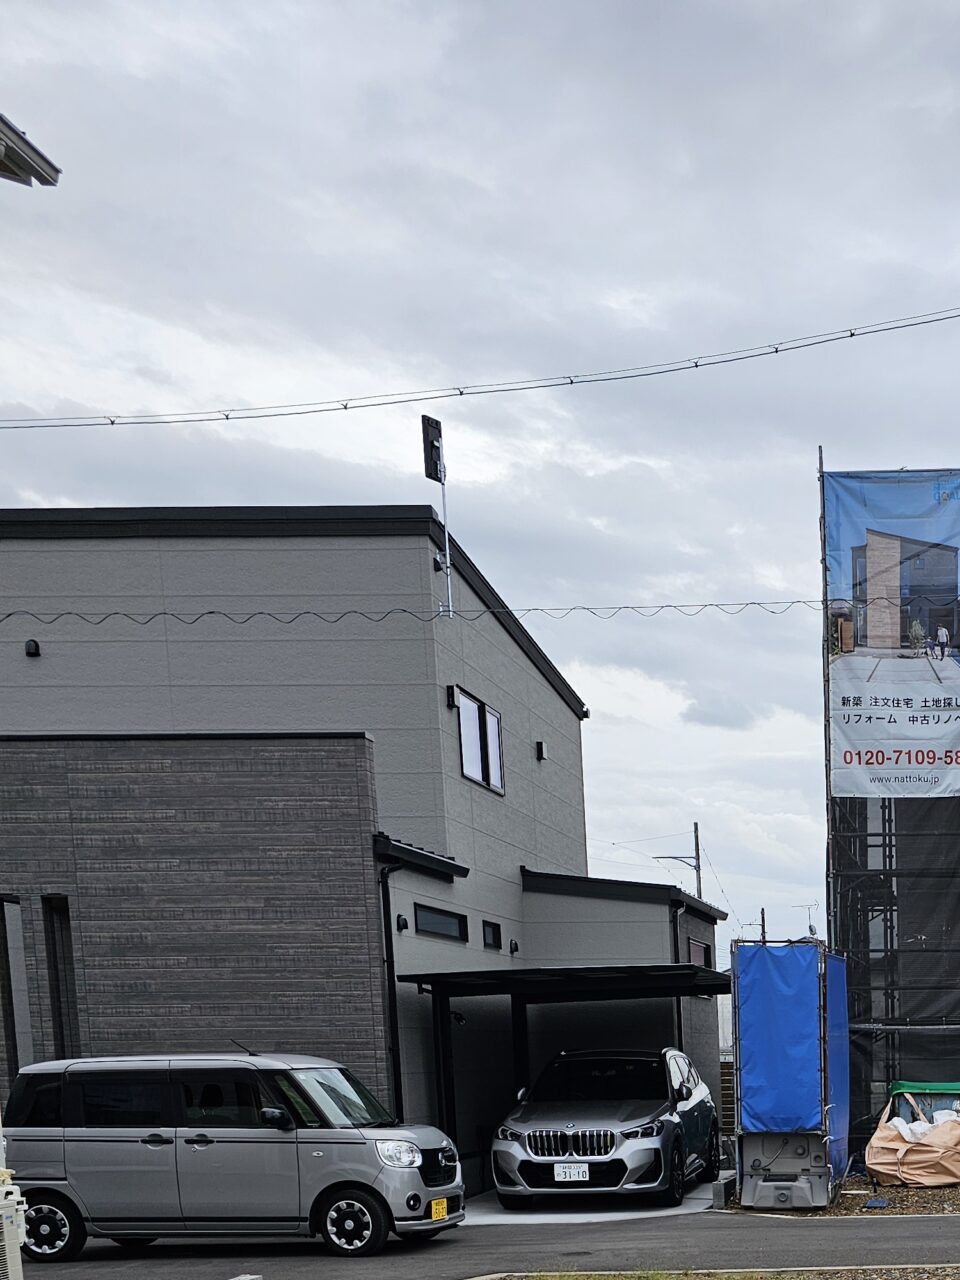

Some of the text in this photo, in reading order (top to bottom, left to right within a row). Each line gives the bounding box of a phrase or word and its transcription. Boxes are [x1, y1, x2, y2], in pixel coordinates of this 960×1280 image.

[841, 696, 863, 708] 新築
[869, 696, 914, 709] 注文住宅
[842, 714, 898, 726] リフォーム
[869, 774, 940, 786] www.nattoku.jp
